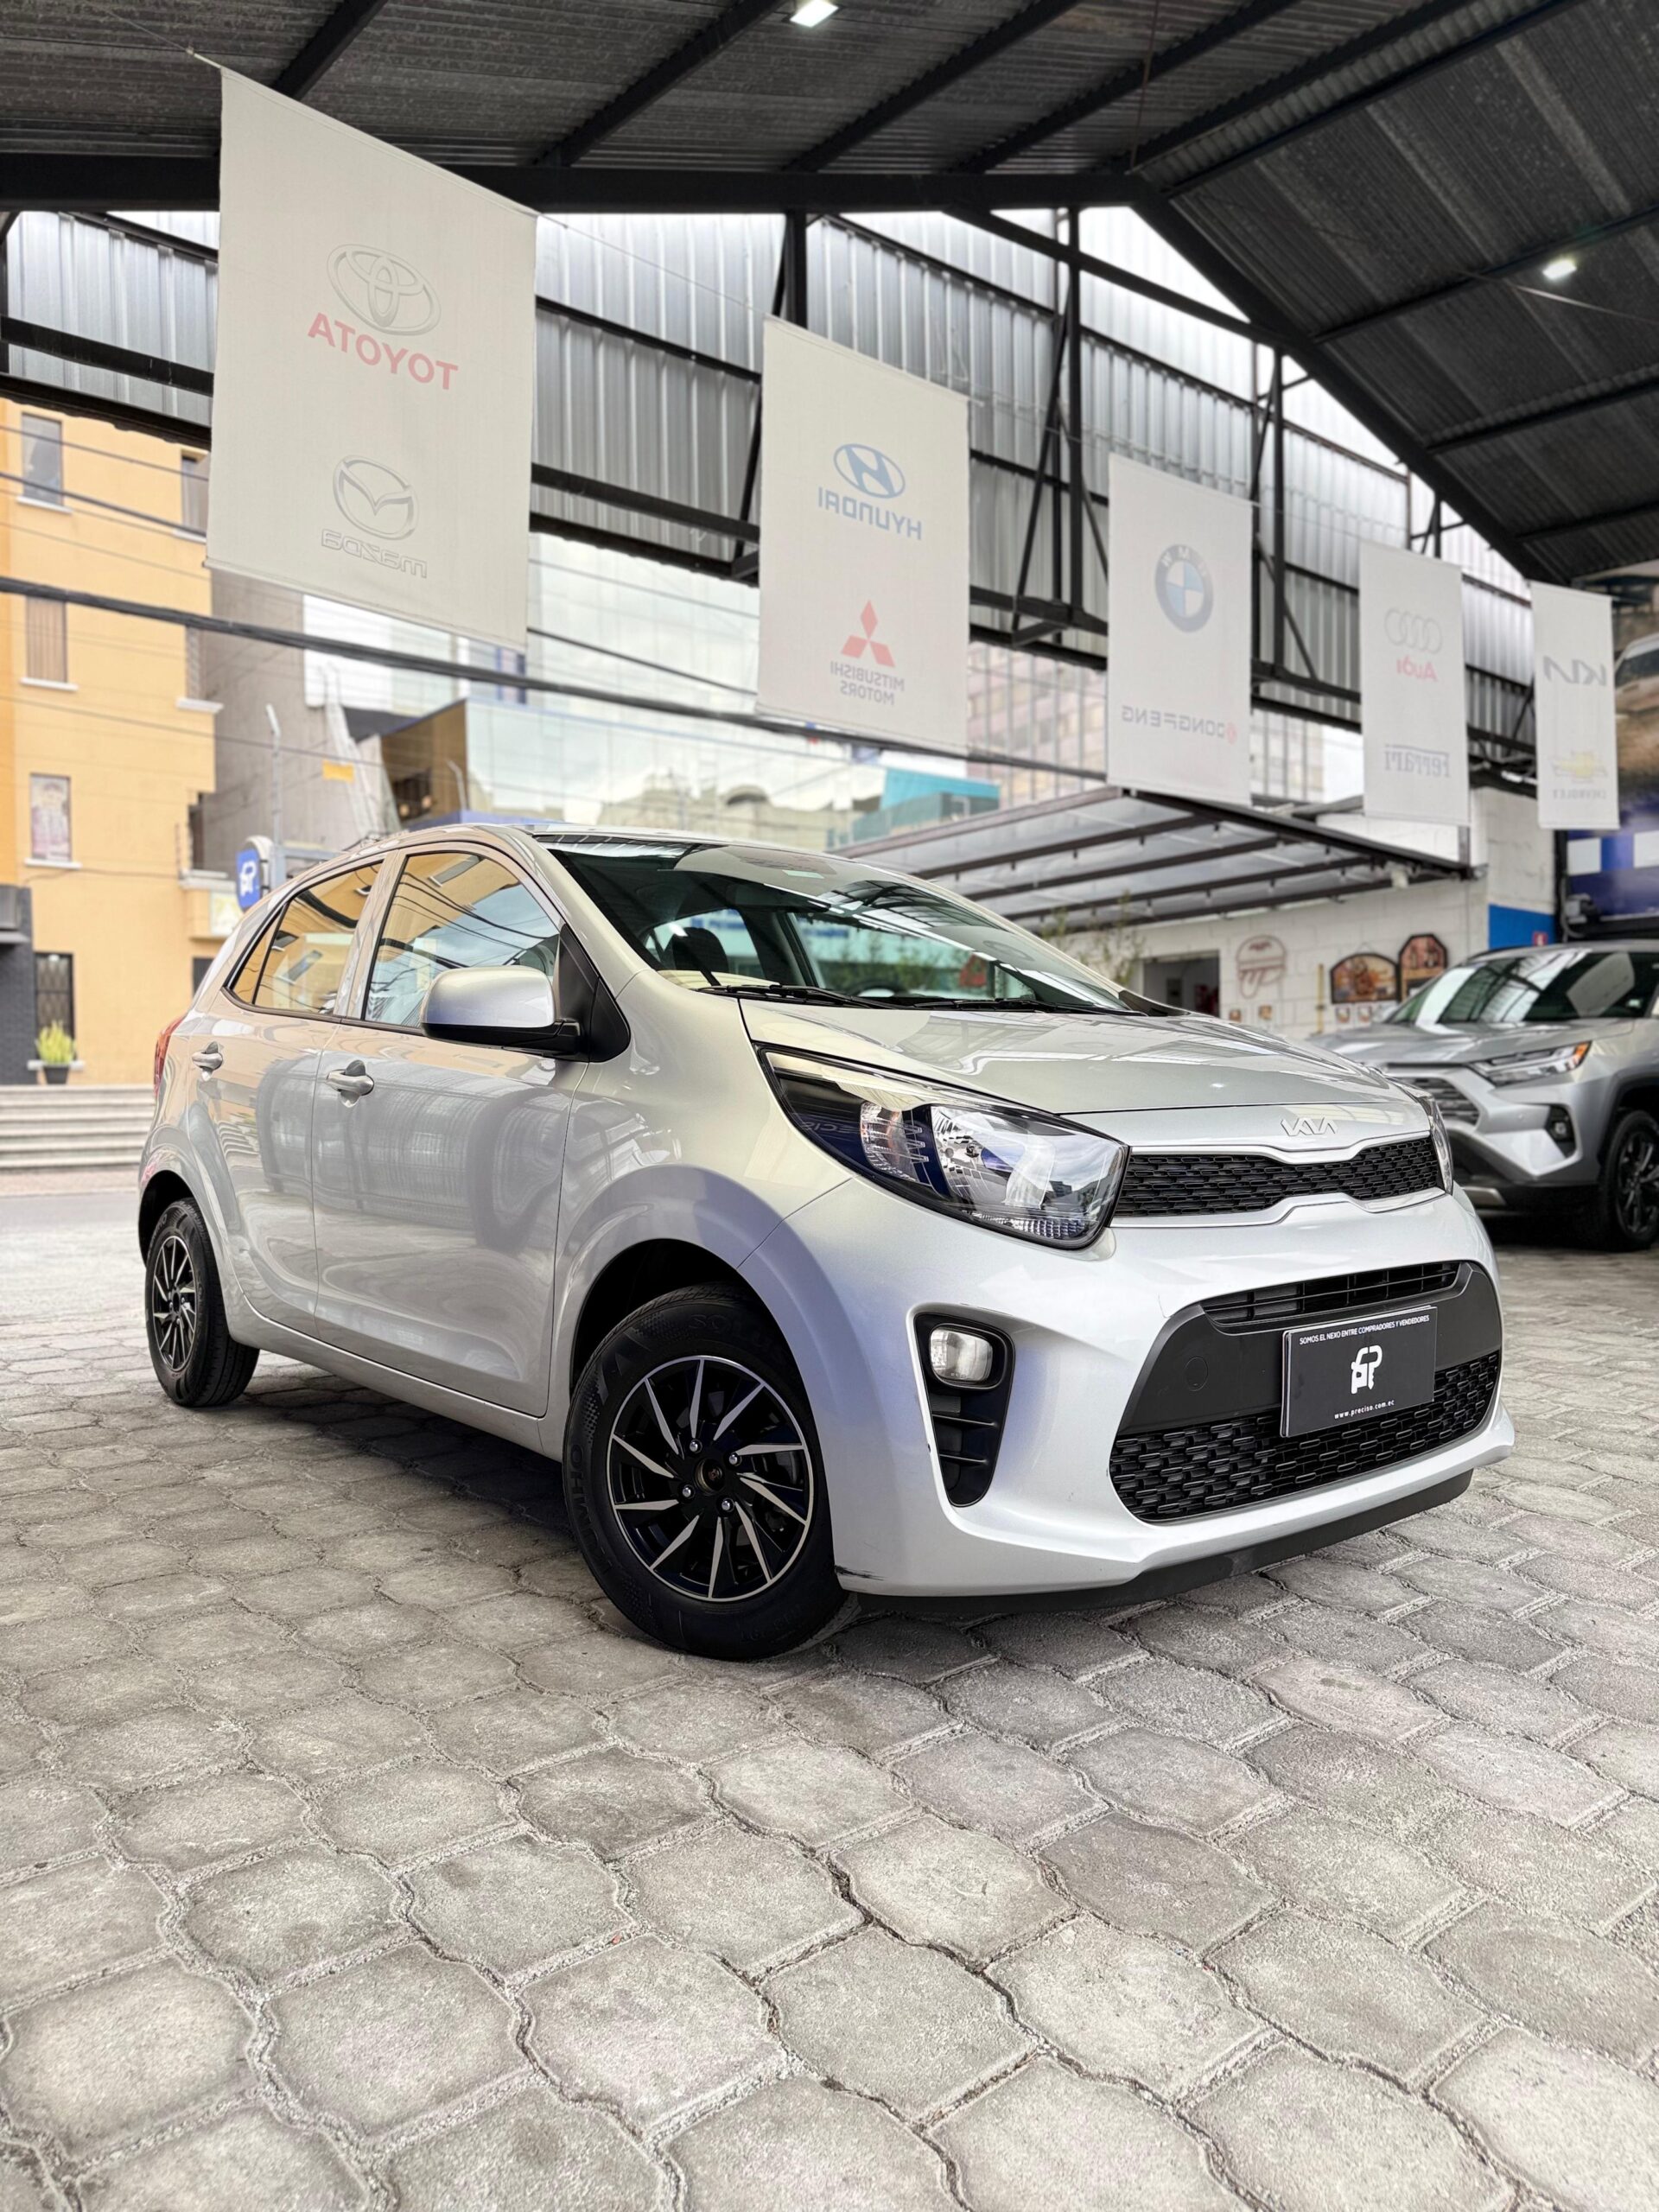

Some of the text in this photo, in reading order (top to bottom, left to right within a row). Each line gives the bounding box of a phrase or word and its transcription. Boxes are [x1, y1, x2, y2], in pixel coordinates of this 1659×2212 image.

[1280, 1116, 1338, 1137] KIA
[1299, 1334, 1319, 1345] SOMOS
[1319, 1333, 1326, 1342] EL
[1326, 1331, 1341, 1340] NEXO
[1341, 1327, 1358, 1338] ENTRE
[1357, 1320, 1395, 1335] COMPRADORES
[1398, 1314, 1430, 1326] VENDEDORES
[1334, 1399, 1395, 1420] www.preciso.com.ec
